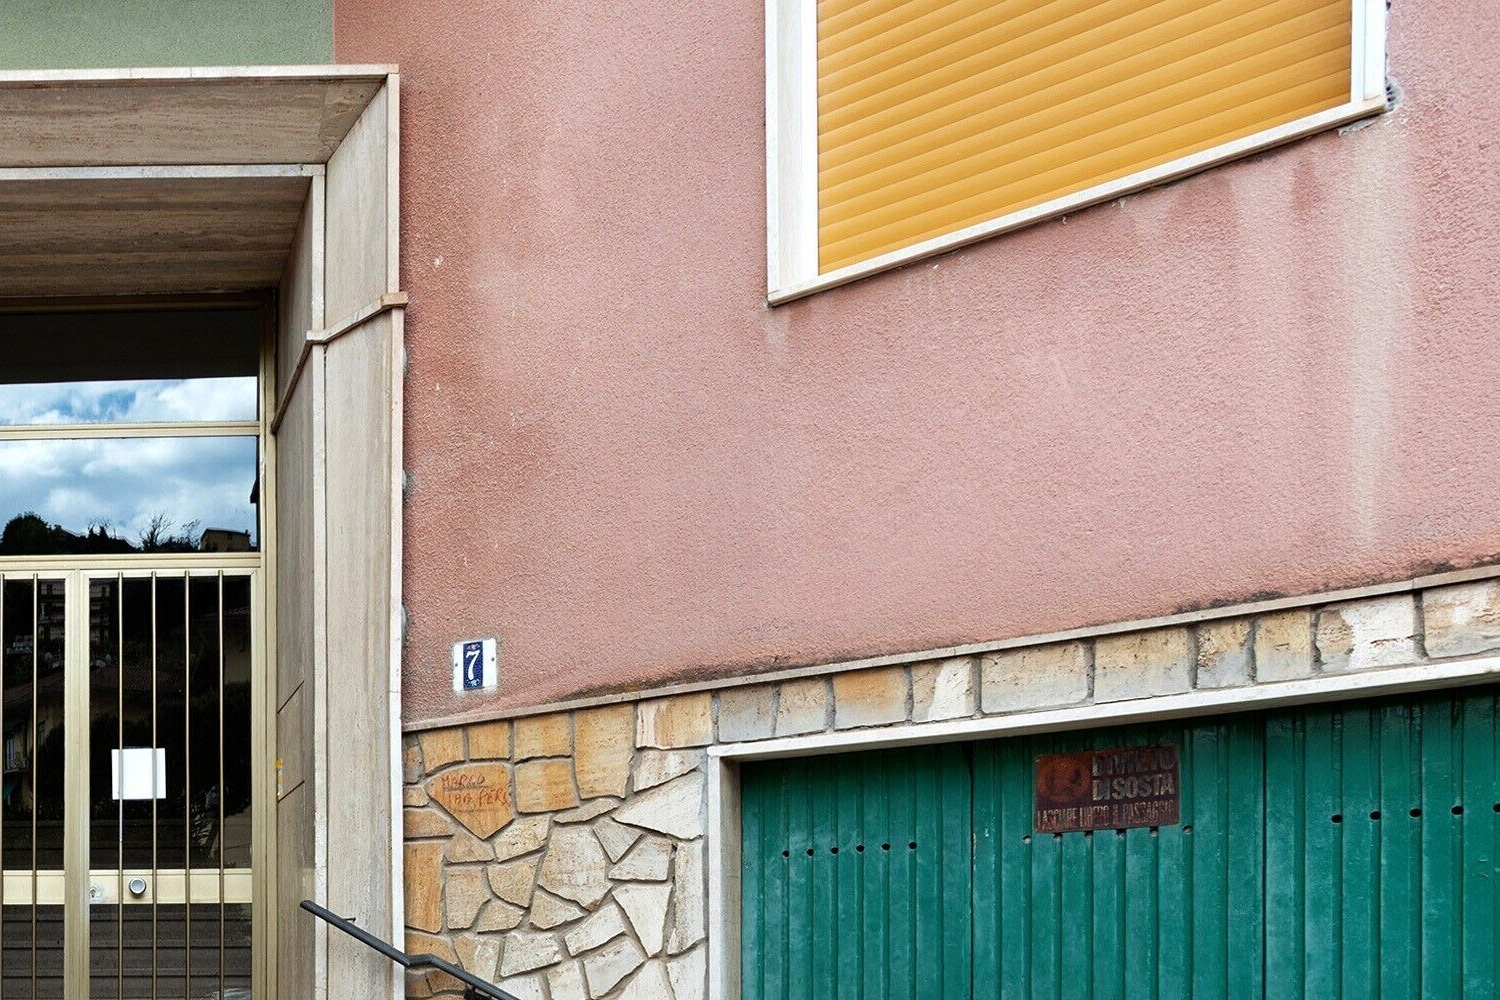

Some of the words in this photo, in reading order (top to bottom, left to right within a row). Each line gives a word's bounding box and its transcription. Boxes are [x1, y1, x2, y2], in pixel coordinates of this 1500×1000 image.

[465, 649, 481, 681] 7
[1092, 750, 1175, 777] DIVIETO
[1092, 778, 1111, 801] DI
[1112, 773, 1176, 800] SOSTA
